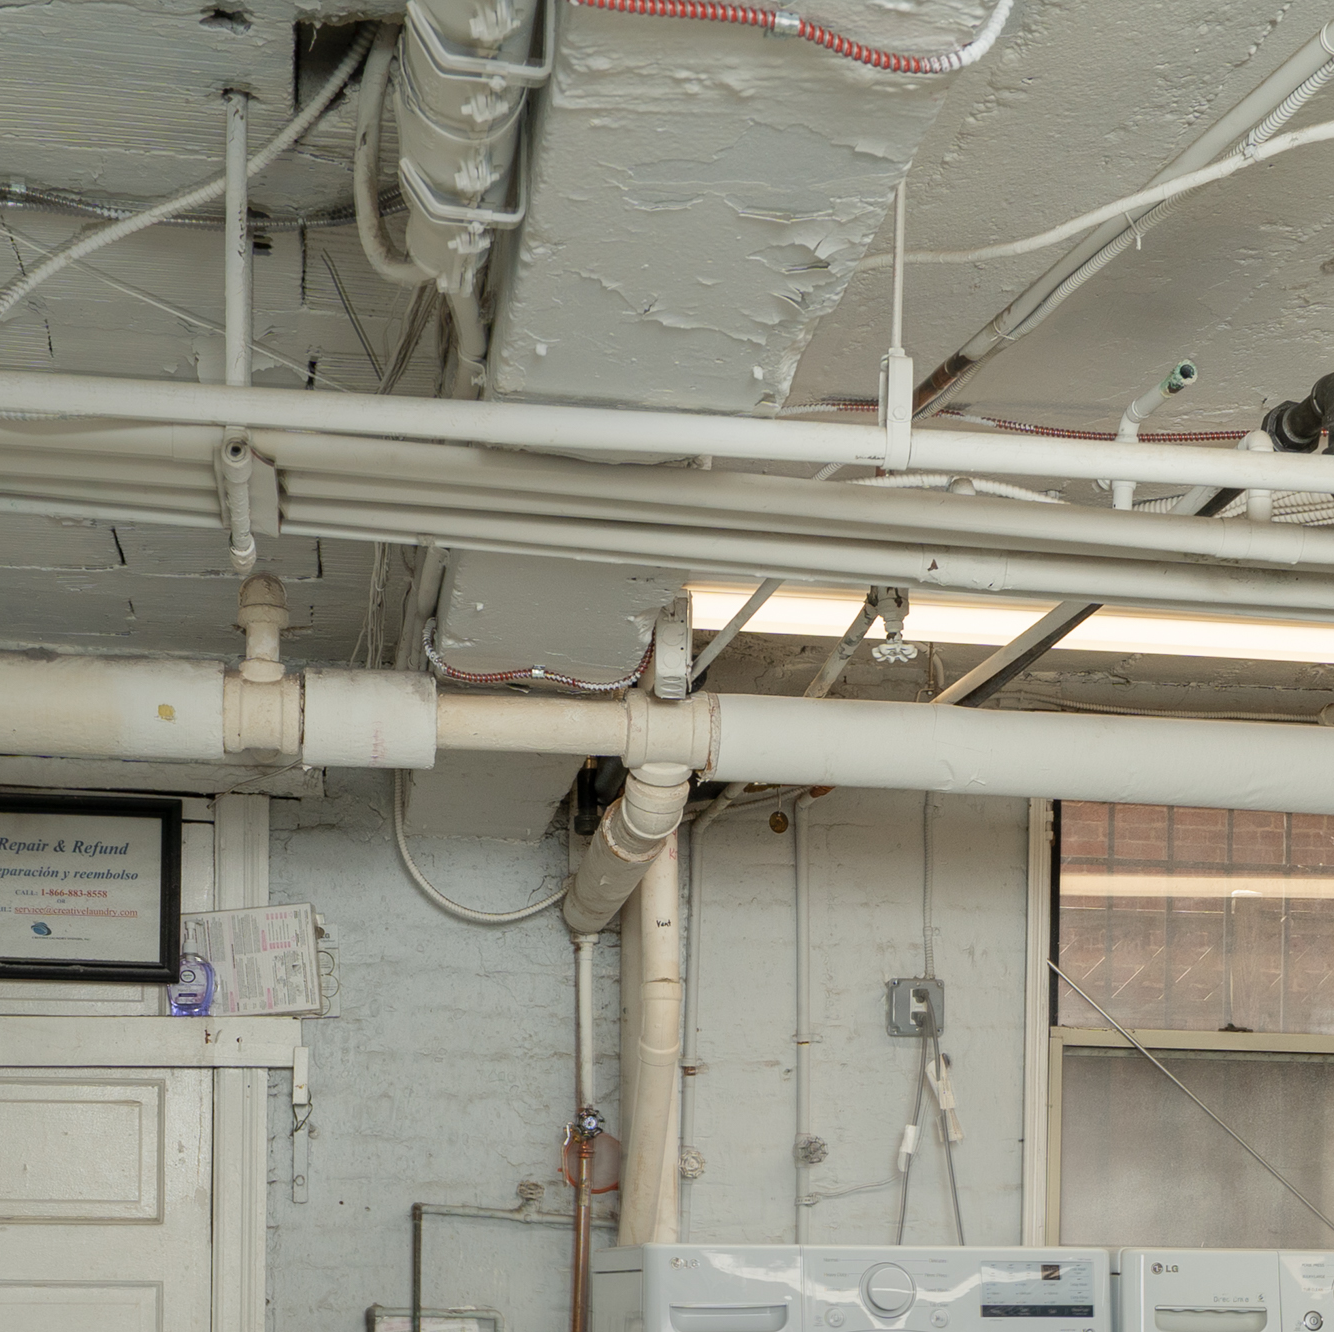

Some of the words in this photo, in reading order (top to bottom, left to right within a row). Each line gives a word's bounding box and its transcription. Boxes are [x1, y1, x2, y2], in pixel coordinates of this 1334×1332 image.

[53, 839, 66, 853] &
[72, 840, 129, 857] Refund
[60, 870, 70, 881] y
[73, 869, 139, 880] reembolso
[41, 888, 108, 898] 1-866-883-8558
[14, 906, 139, 918] service@creativelaundry.com
[1165, 1265, 1179, 1273] LG
